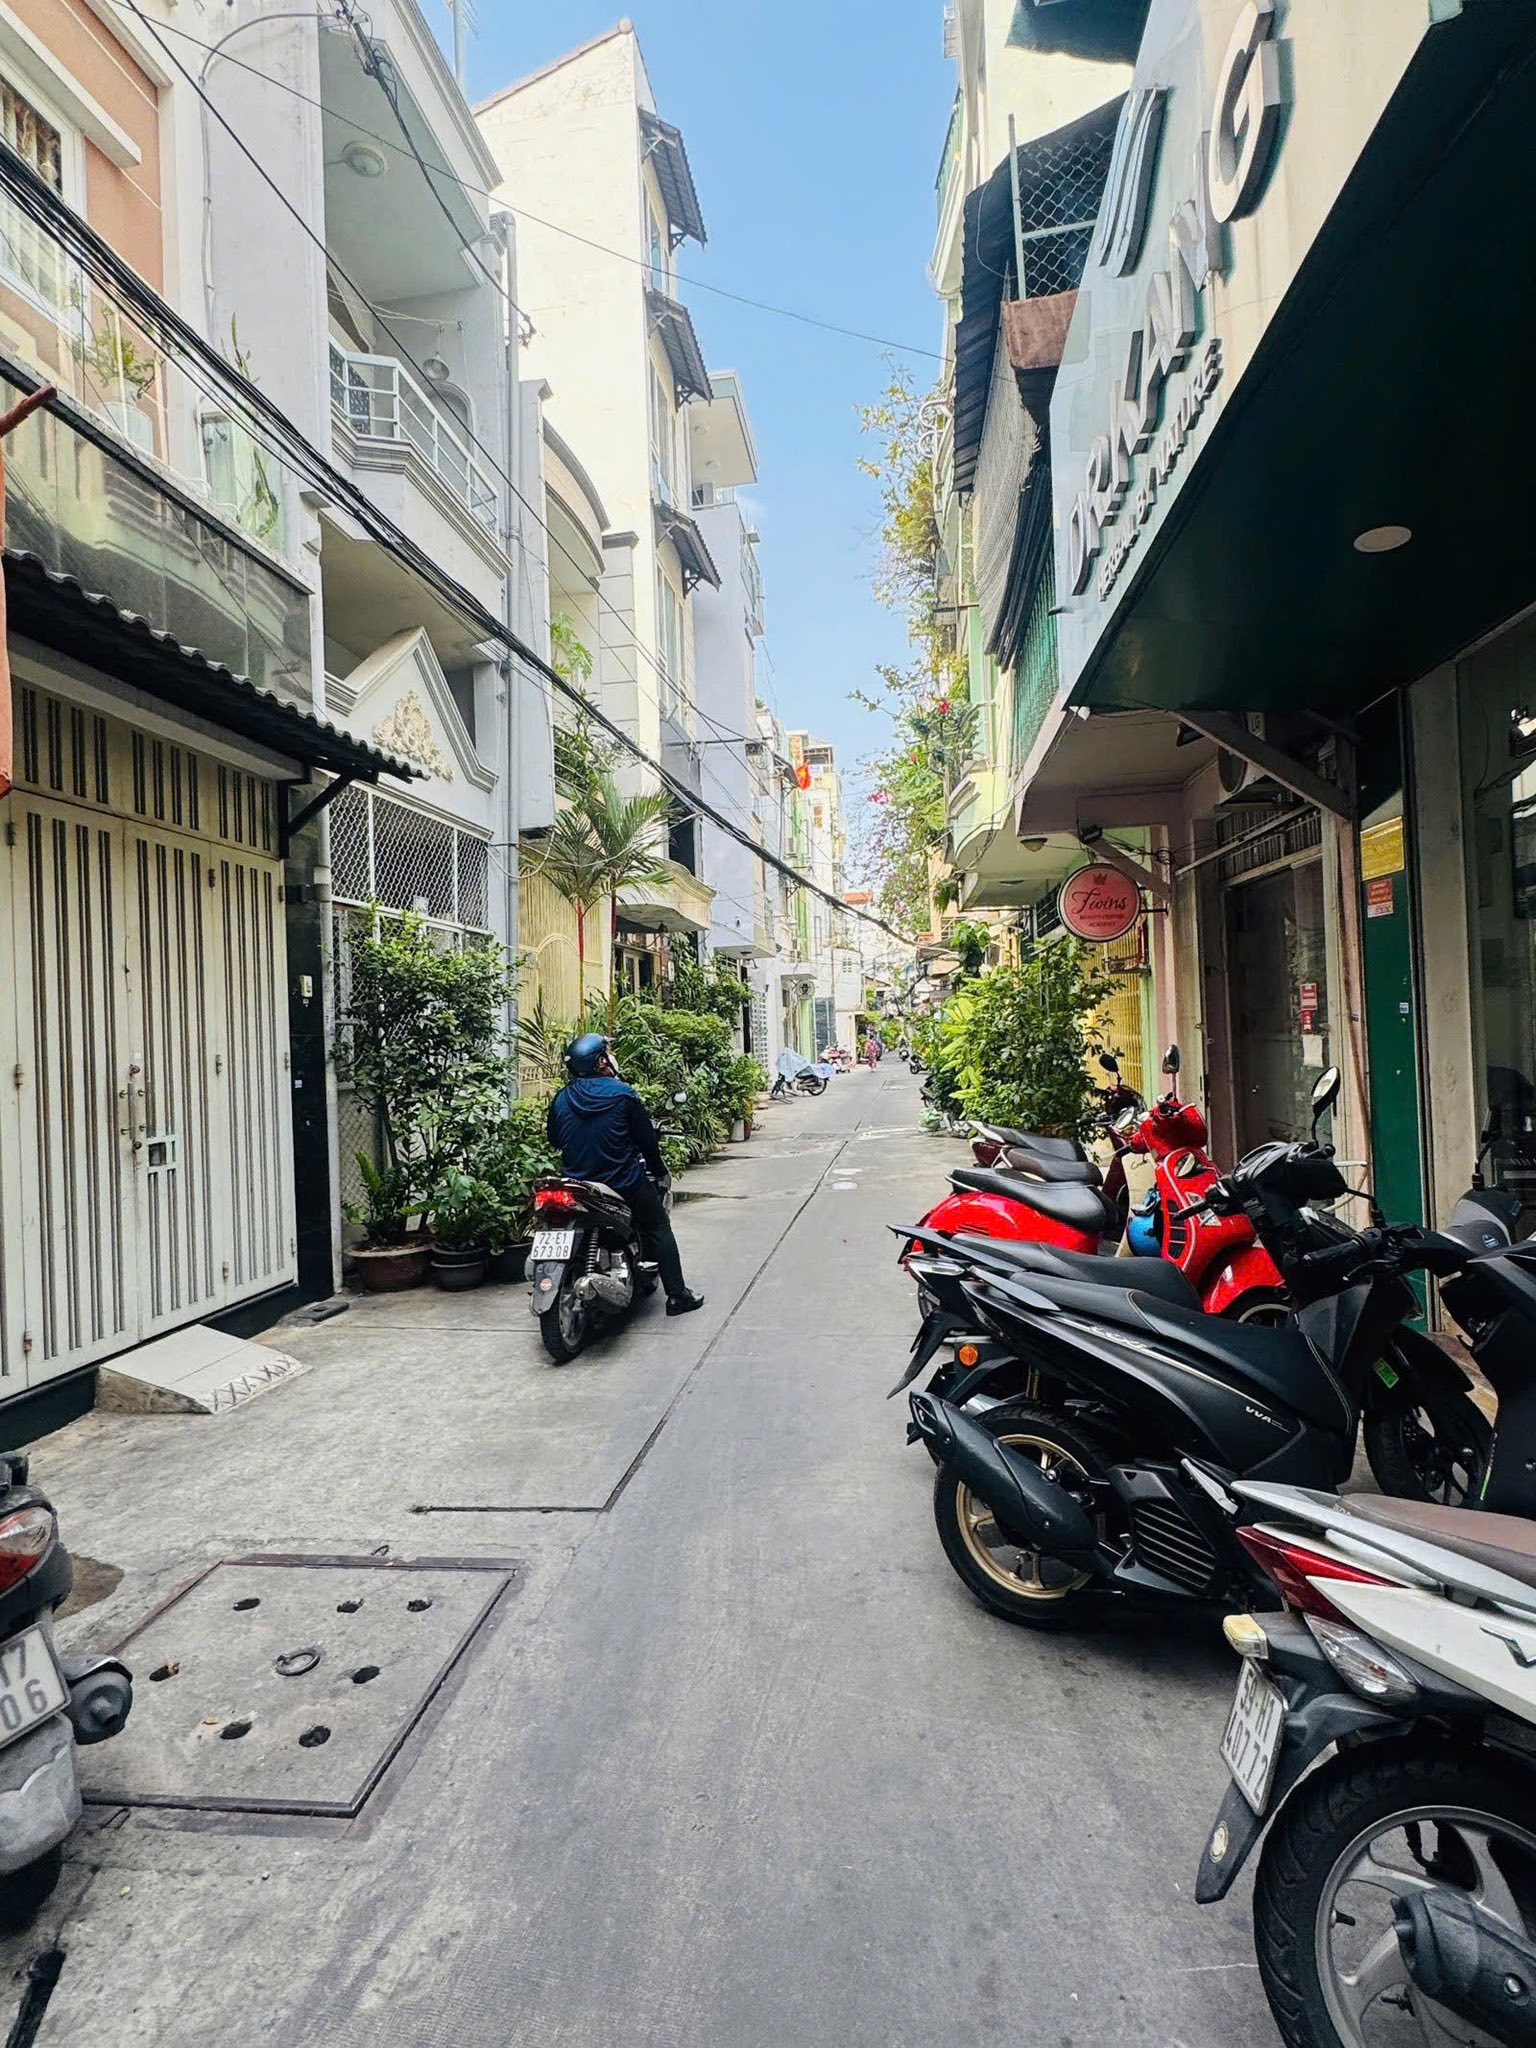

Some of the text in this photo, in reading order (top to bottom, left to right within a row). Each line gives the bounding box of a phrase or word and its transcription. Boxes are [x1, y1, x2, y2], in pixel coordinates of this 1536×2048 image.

[1136, 467, 1157, 525] BY
[1158, 338, 1222, 485] NATURE
[1072, 888, 1128, 914] Twins
